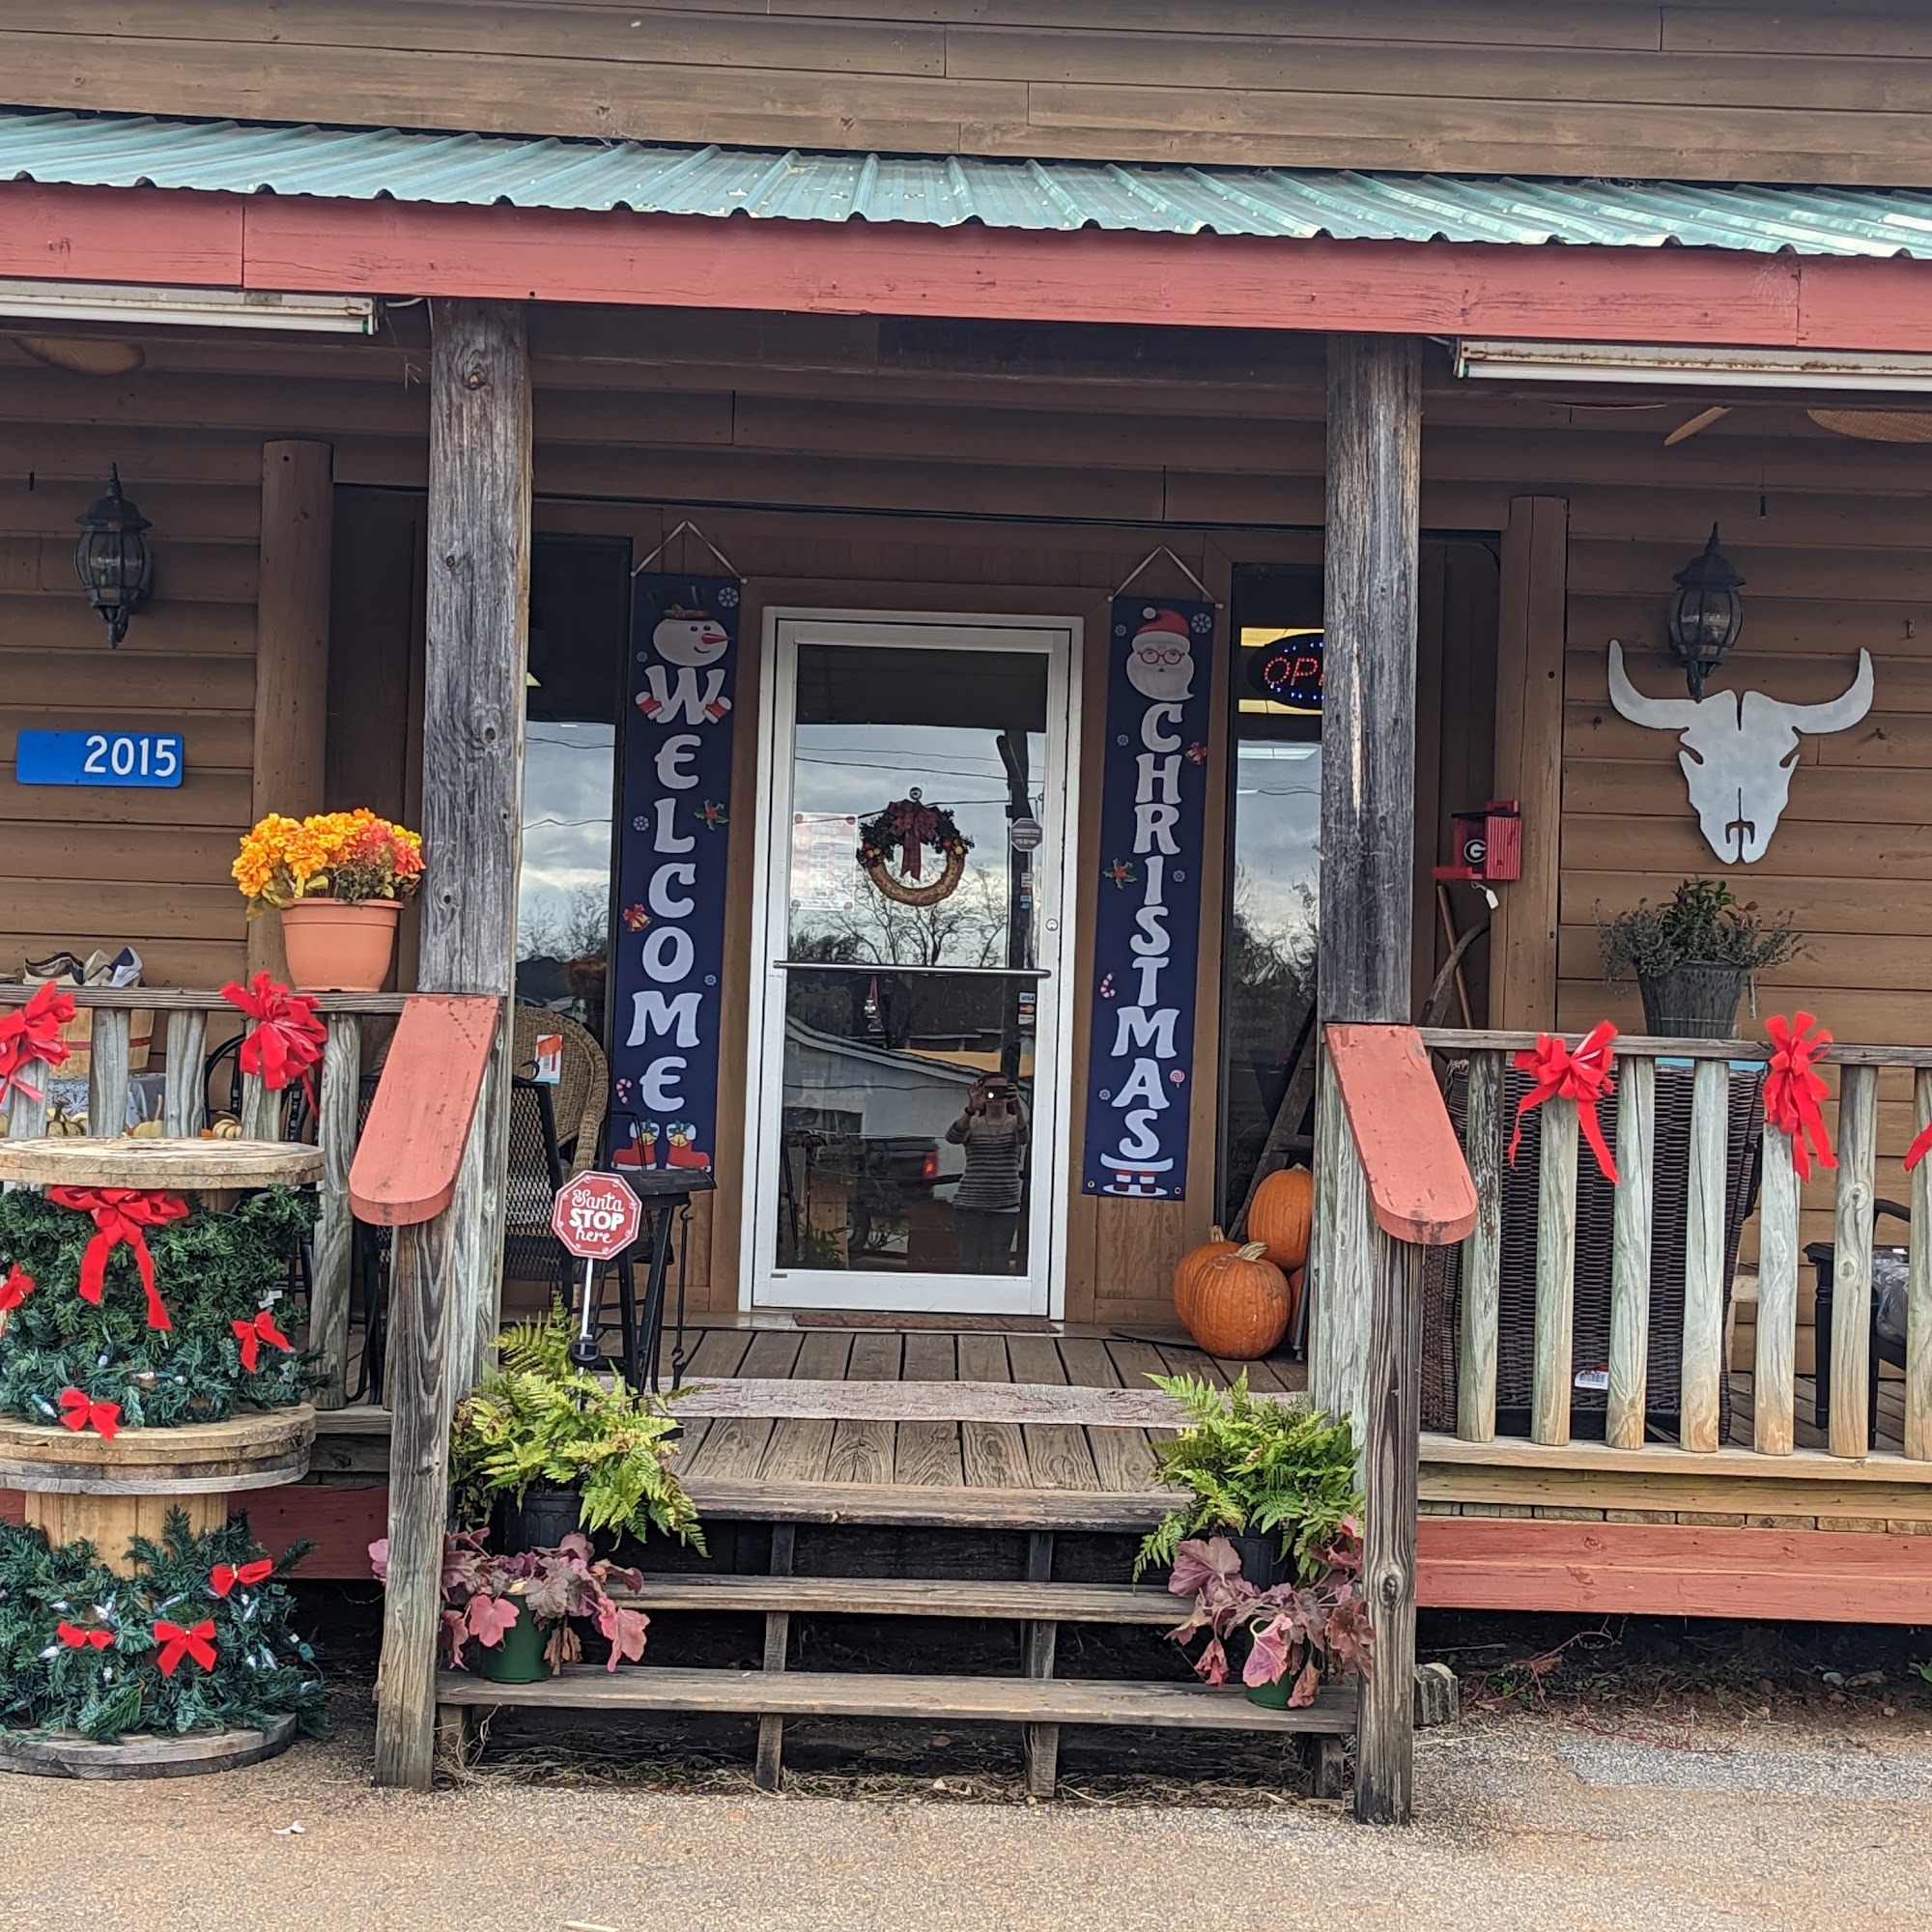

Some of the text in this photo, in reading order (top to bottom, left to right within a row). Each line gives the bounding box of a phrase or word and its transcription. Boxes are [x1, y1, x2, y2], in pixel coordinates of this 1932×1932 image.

[1264, 657, 1324, 686] OP
[83, 735, 177, 778] 2015
[1463, 838, 1486, 864] G
[625, 665, 726, 1113] WELCOME
[1110, 703, 1183, 1160] CHRISTMAS
[571, 1189, 625, 1212] Santa
[568, 1208, 625, 1231] STOP
[575, 1225, 613, 1244] here
